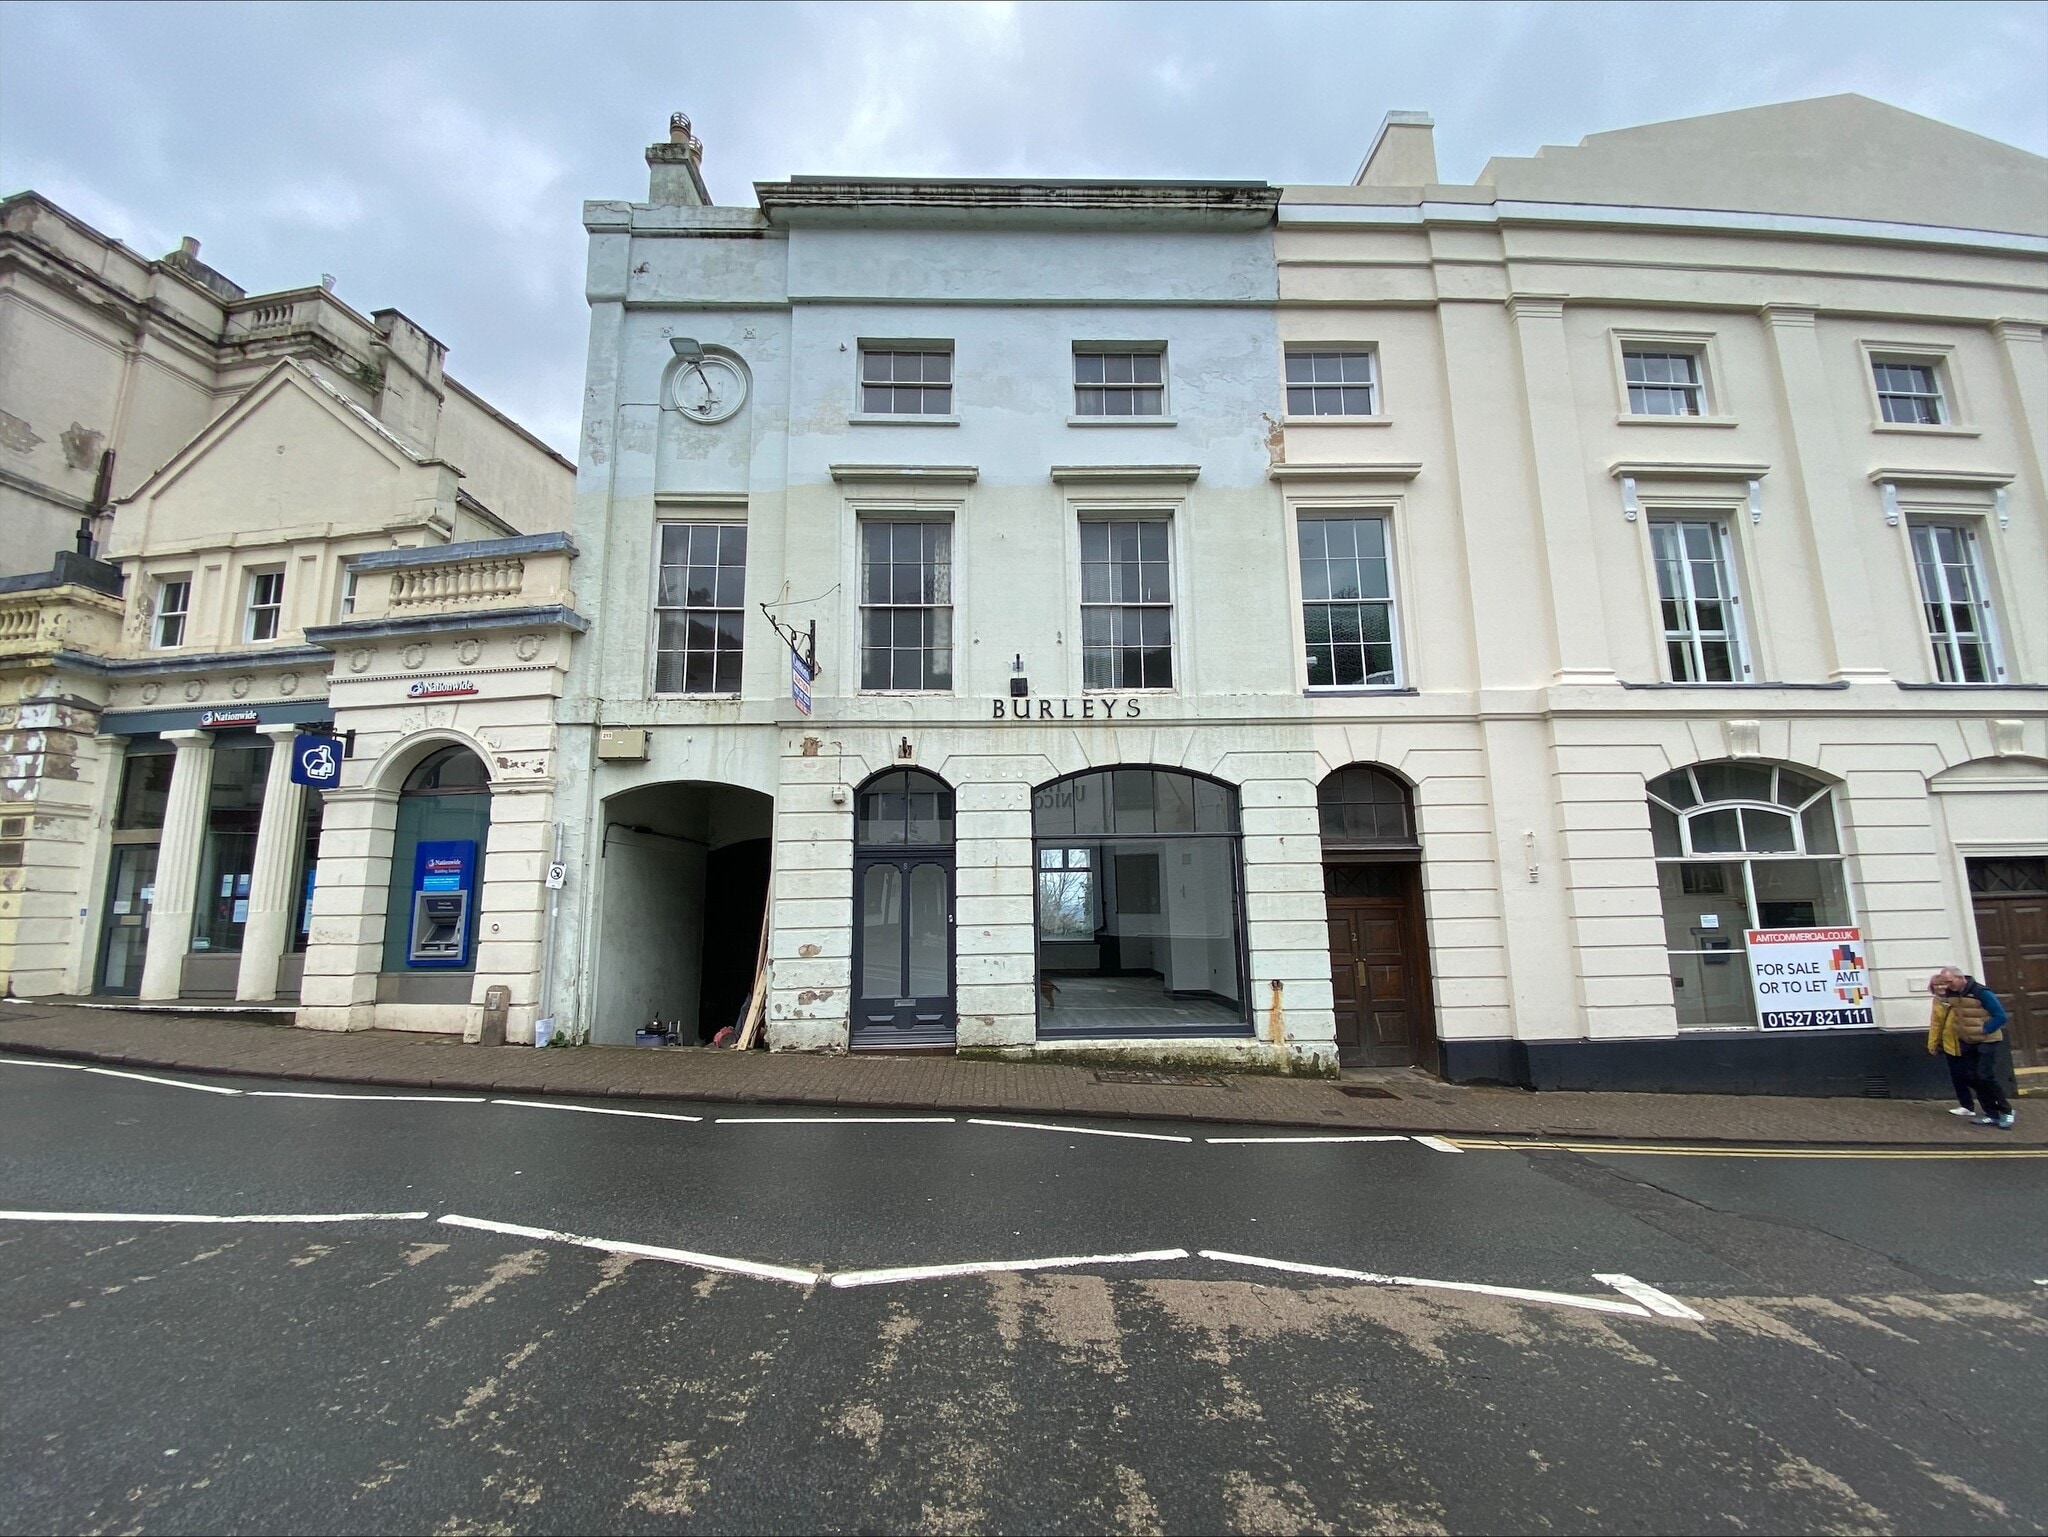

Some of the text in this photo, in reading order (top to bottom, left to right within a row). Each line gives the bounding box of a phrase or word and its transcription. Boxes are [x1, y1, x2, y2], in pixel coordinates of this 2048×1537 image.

[424, 680, 474, 692] Nationwide
[992, 698, 1141, 719] BURLEYS
[213, 710, 258, 722] Nationwide
[1351, 932, 1358, 942] 2
[1755, 931, 1854, 943] AMTCOMMERCIAL.CO.UK
[1756, 962, 1820, 976] FOR SALE
[1836, 971, 1860, 982] AMT
[1759, 980, 1828, 994] OR TO LET
[1768, 1009, 1869, 1028] 01527 821 111
